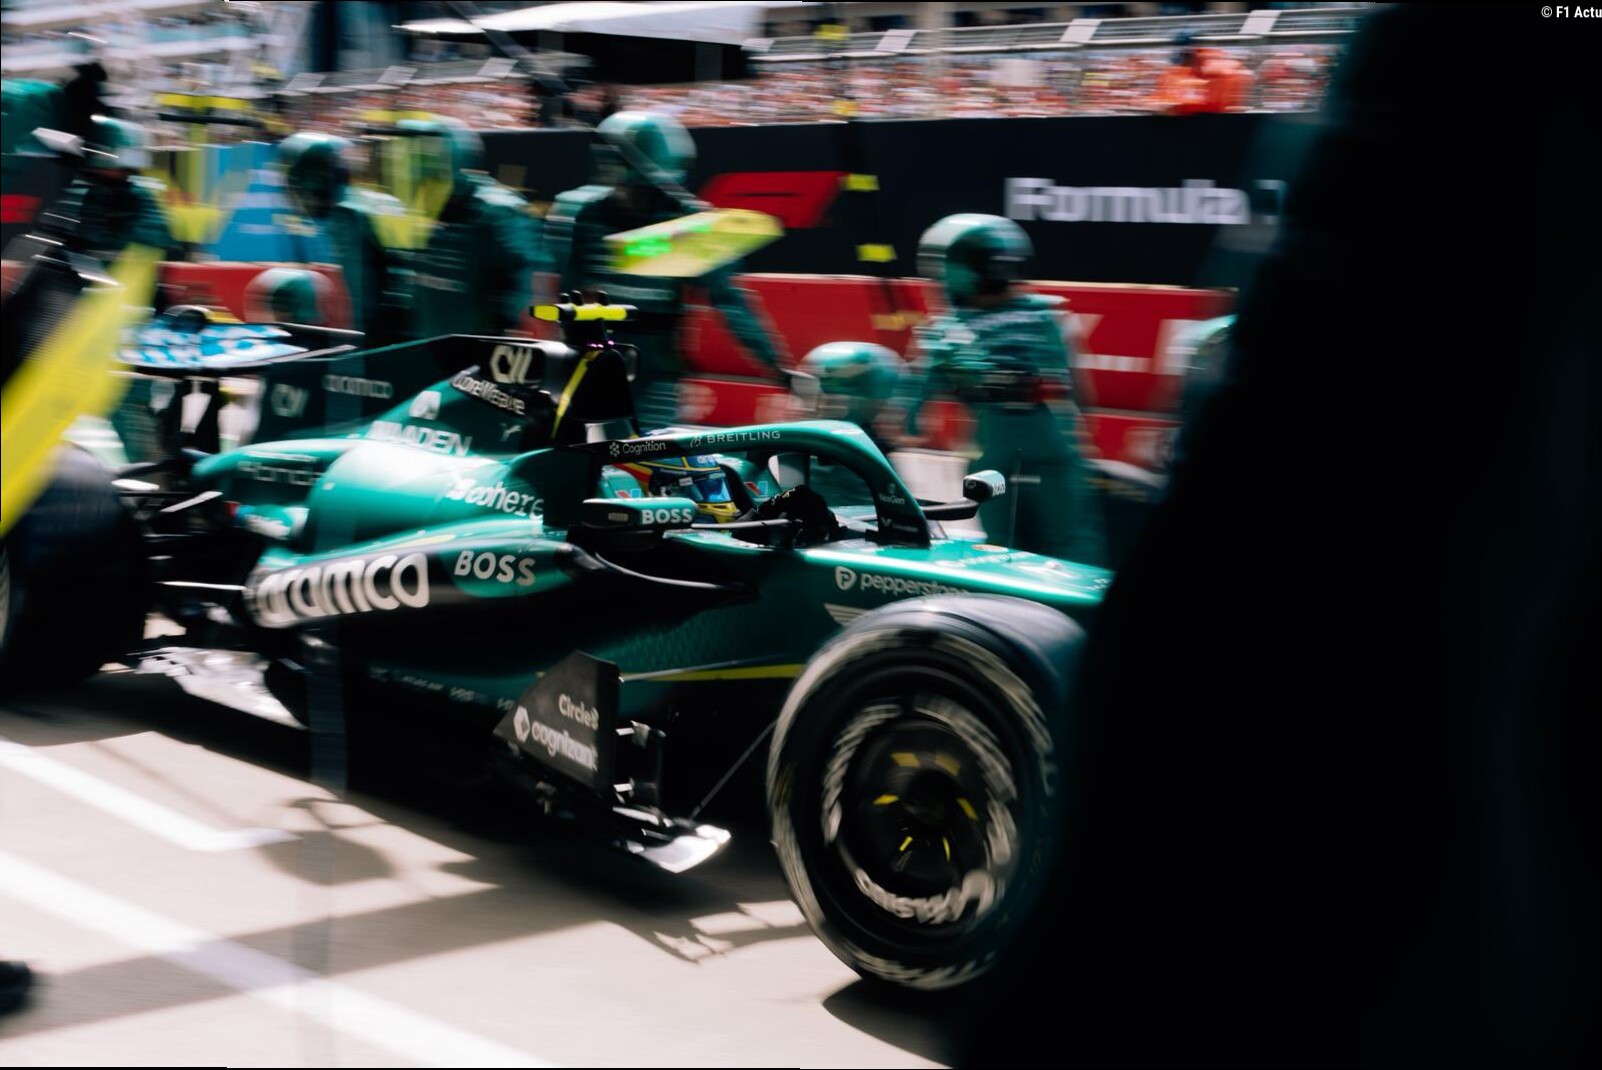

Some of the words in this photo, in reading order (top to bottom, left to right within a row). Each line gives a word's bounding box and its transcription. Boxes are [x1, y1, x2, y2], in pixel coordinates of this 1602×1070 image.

[1004, 177, 1249, 224] Formula
[622, 440, 666, 455] Cognition
[707, 430, 781, 444] BREITLING
[641, 508, 694, 526] BOSS
[454, 550, 536, 586] BOSS
[256, 552, 430, 628] aramco
[531, 720, 599, 772] cognizant
